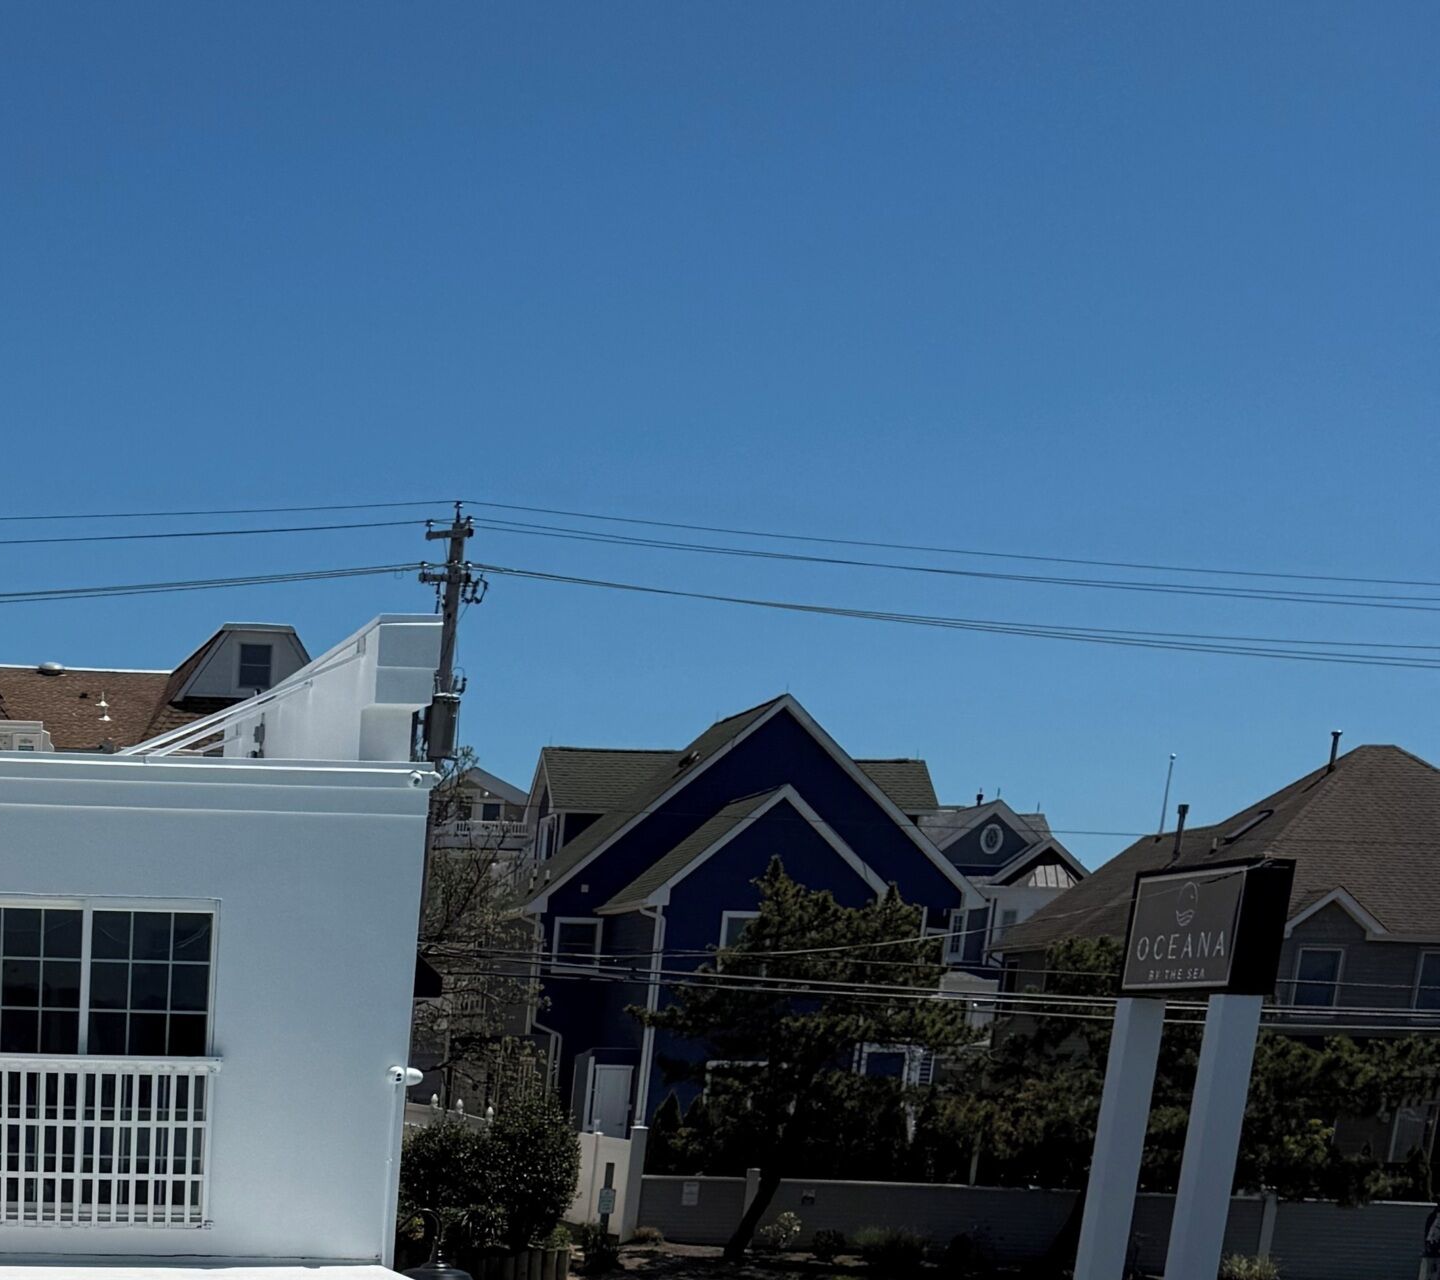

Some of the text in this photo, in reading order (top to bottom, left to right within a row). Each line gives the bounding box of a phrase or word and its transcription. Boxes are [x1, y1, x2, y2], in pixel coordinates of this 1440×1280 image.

[1136, 930, 1225, 961] OCEANA
[1148, 967, 1205, 981] BY THE SEA
